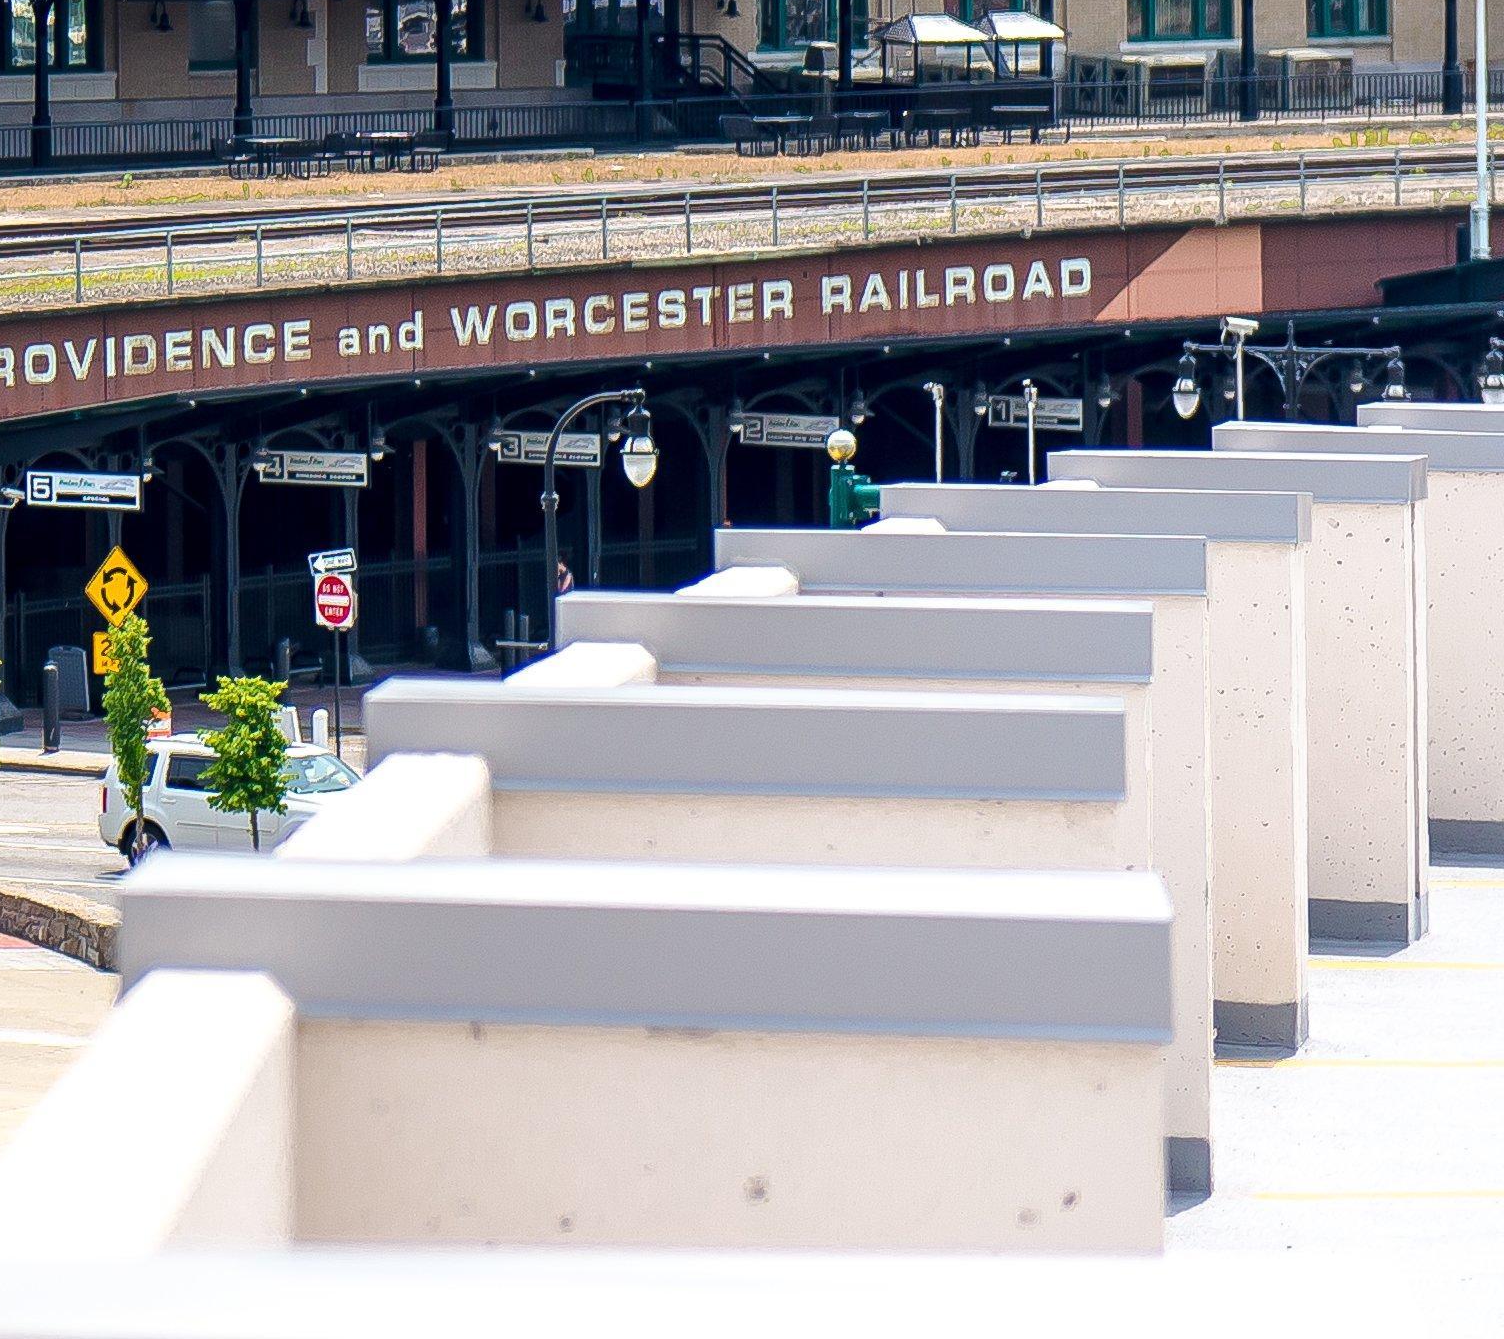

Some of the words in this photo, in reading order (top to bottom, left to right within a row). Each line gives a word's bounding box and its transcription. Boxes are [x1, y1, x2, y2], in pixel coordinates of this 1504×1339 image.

[337, 310, 424, 358] and
[450, 279, 794, 347] WORCESTER
[821, 257, 1092, 315] RAILROAD
[747, 419, 761, 439] 2
[503, 436, 519, 456] 3
[32, 477, 50, 499] 5
[322, 583, 330, 593] DO
[333, 584, 344, 594] NOT
[325, 606, 343, 617] ENTER
